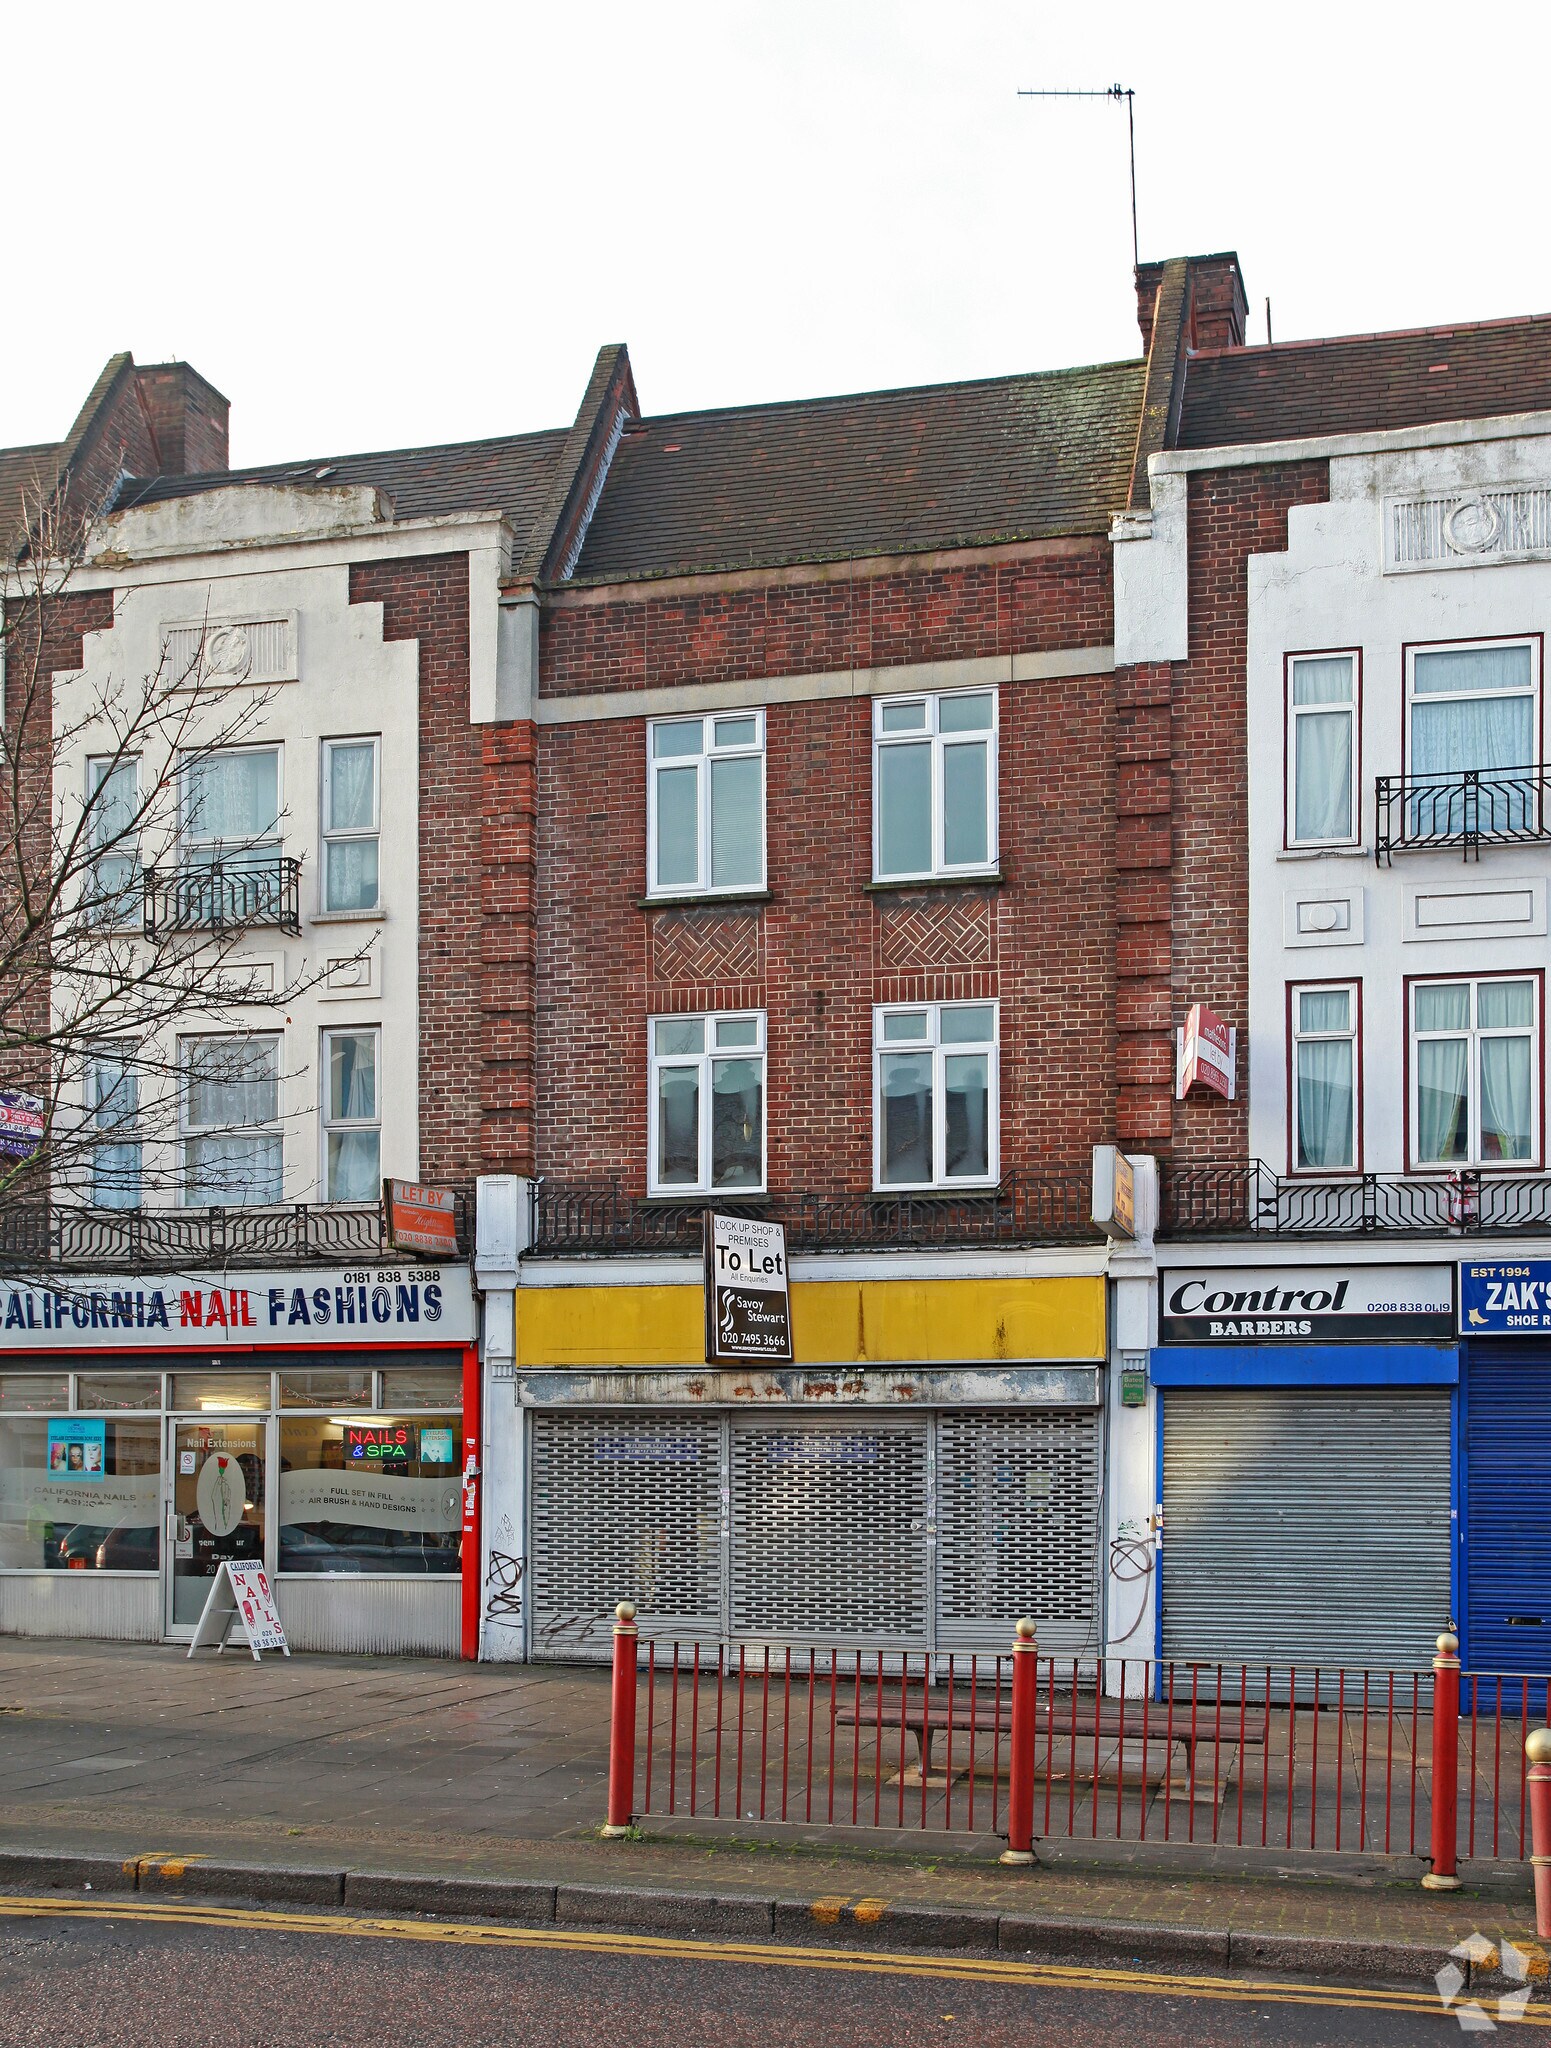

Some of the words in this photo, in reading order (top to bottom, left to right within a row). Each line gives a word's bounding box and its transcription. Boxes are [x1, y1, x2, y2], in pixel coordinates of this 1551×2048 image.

[402, 1186, 424, 1202] LET
[427, 1191, 444, 1205] BY
[715, 1219, 737, 1231] LOCK
[739, 1223, 750, 1233] UP
[752, 1225, 774, 1236] SHOP
[775, 1228, 781, 1237] &
[399, 1231, 412, 1242] 020
[415, 1234, 432, 1245] 8838
[728, 1234, 769, 1248] PREMISES
[716, 1244, 741, 1271] To
[749, 1248, 784, 1276] Let
[343, 1272, 370, 1284] 0181
[377, 1271, 401, 1283] 838
[408, 1270, 441, 1282] 5388
[730, 1273, 739, 1281] All
[740, 1273, 769, 1284] Enquiries
[1470, 1268, 1496, 1277] EST
[1498, 1267, 1531, 1277] 1994
[736, 1296, 764, 1312] Savoy
[1168, 1279, 1350, 1315] Control
[0, 1291, 169, 1329] ALIFORNIA
[180, 1289, 257, 1327] NAIL
[268, 1284, 442, 1325] FASHIONS
[1367, 1302, 1397, 1313] 0208
[1399, 1302, 1422, 1313] 838
[748, 1310, 785, 1324] Stewart
[1506, 1315, 1539, 1326] SHOE
[1209, 1320, 1312, 1336] BARBERS
[722, 1332, 738, 1344] 020
[740, 1333, 761, 1345] 7495
[763, 1334, 785, 1346] 3666
[187, 1438, 204, 1448] Nail
[207, 1438, 257, 1448] Extensions
[349, 1430, 407, 1444] NAILS
[352, 1445, 364, 1457] &
[366, 1444, 406, 1457] SPA
[33, 1486, 100, 1499] CALIFORNIA
[103, 1493, 136, 1501] NAILS
[330, 1487, 349, 1496] FULL
[351, 1489, 366, 1497] SET
[367, 1491, 376, 1499] IN
[377, 1492, 393, 1501] FILL
[323, 1497, 350, 1505] BRUSH
[358, 1500, 381, 1509] HAND
[382, 1503, 417, 1513] DESIGNS
[211, 1553, 234, 1561] Day
[230, 1561, 263, 1571] CALIFORNIA
